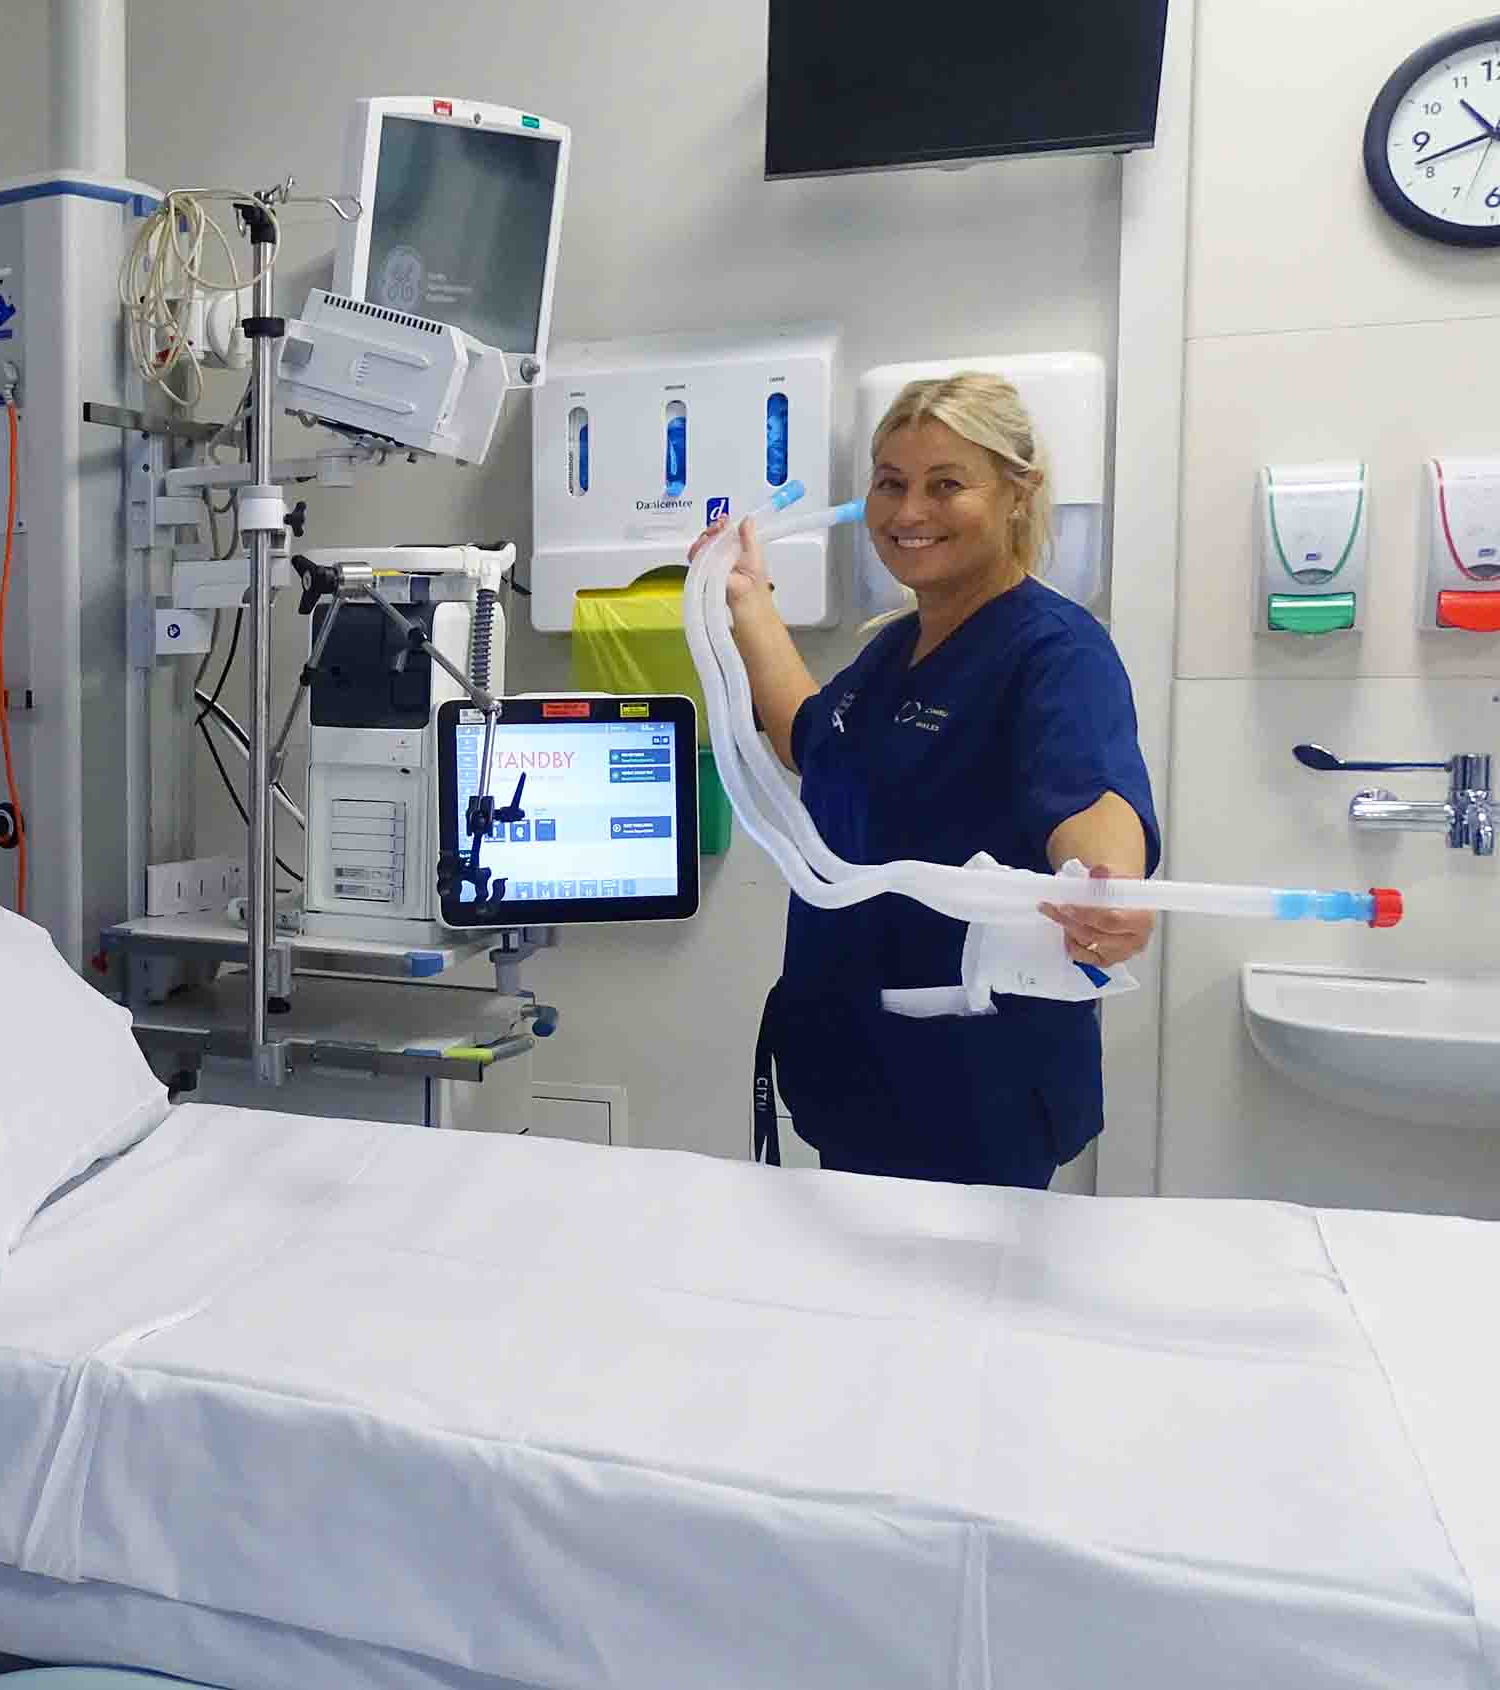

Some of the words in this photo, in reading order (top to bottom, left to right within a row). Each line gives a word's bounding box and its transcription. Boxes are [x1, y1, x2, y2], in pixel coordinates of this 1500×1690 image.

[1452, 76, 1468, 88] 11
[1422, 102, 1442, 115] 10
[1412, 131, 1431, 152] 9
[1425, 166, 1435, 178] 8
[1452, 186, 1460, 199] 7
[1484, 186, 1500, 208] 6
[488, 751, 575, 768] TANDBY
